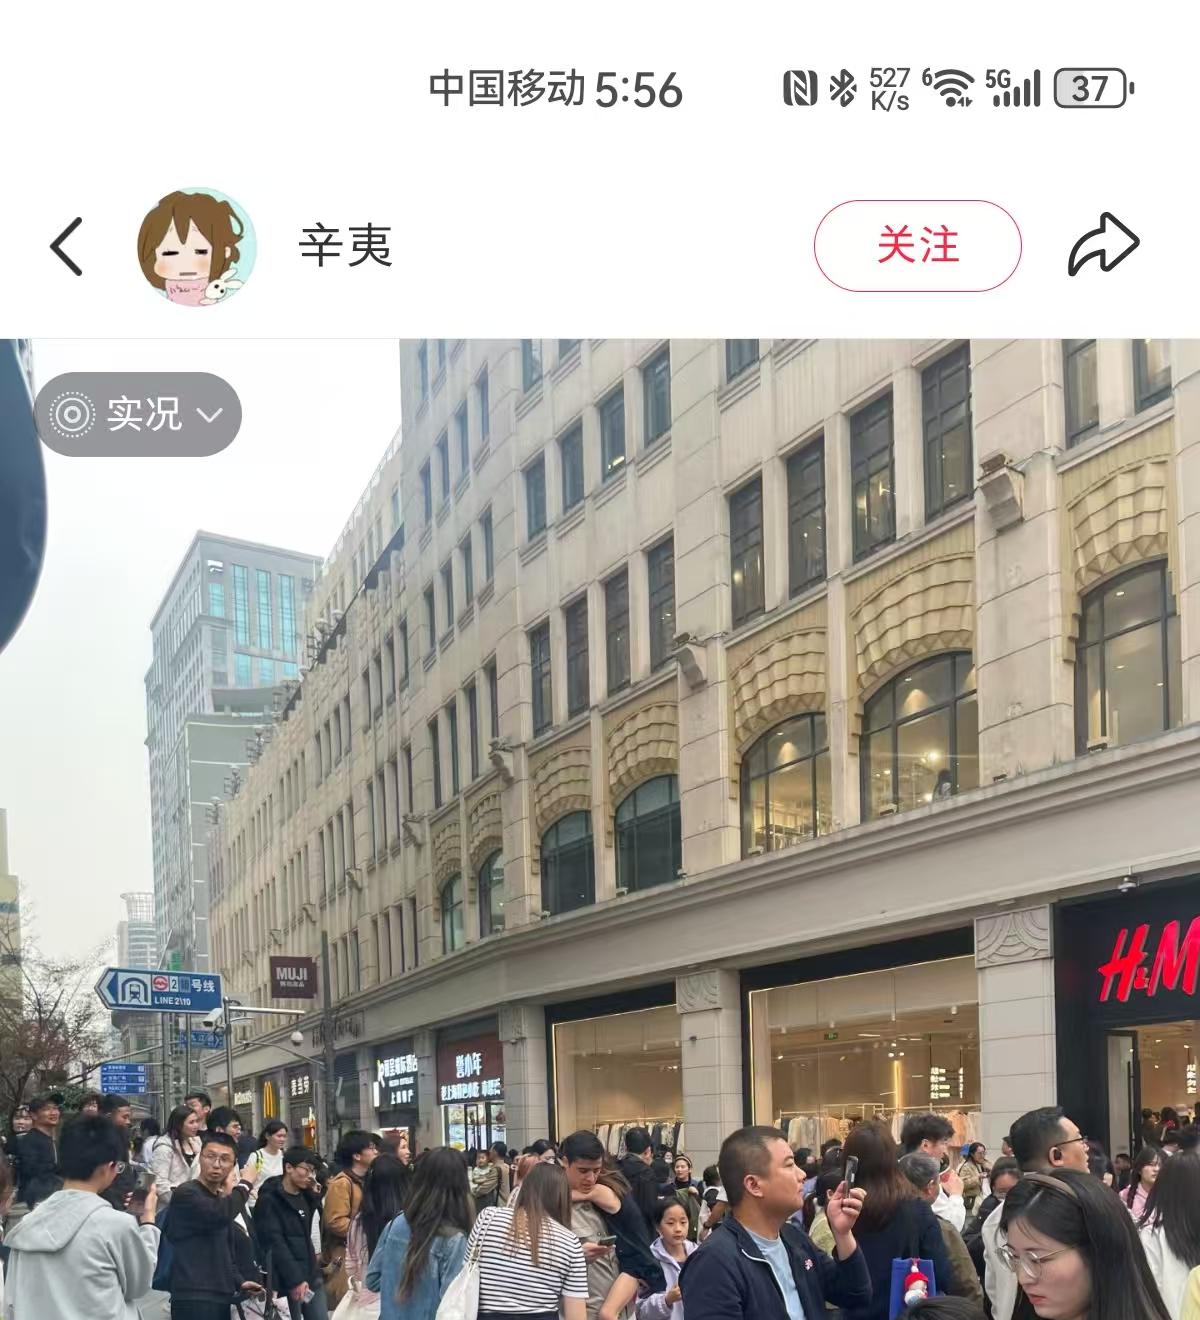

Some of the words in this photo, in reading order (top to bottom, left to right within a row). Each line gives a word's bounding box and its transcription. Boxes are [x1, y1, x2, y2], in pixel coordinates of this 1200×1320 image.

[1098, 916, 1200, 1002] H&M
[276, 967, 307, 981] MUJI
[192, 979, 215, 993] 号线
[154, 997, 174, 1005] LINE
[291, 1076, 309, 1096] 麦当劳
